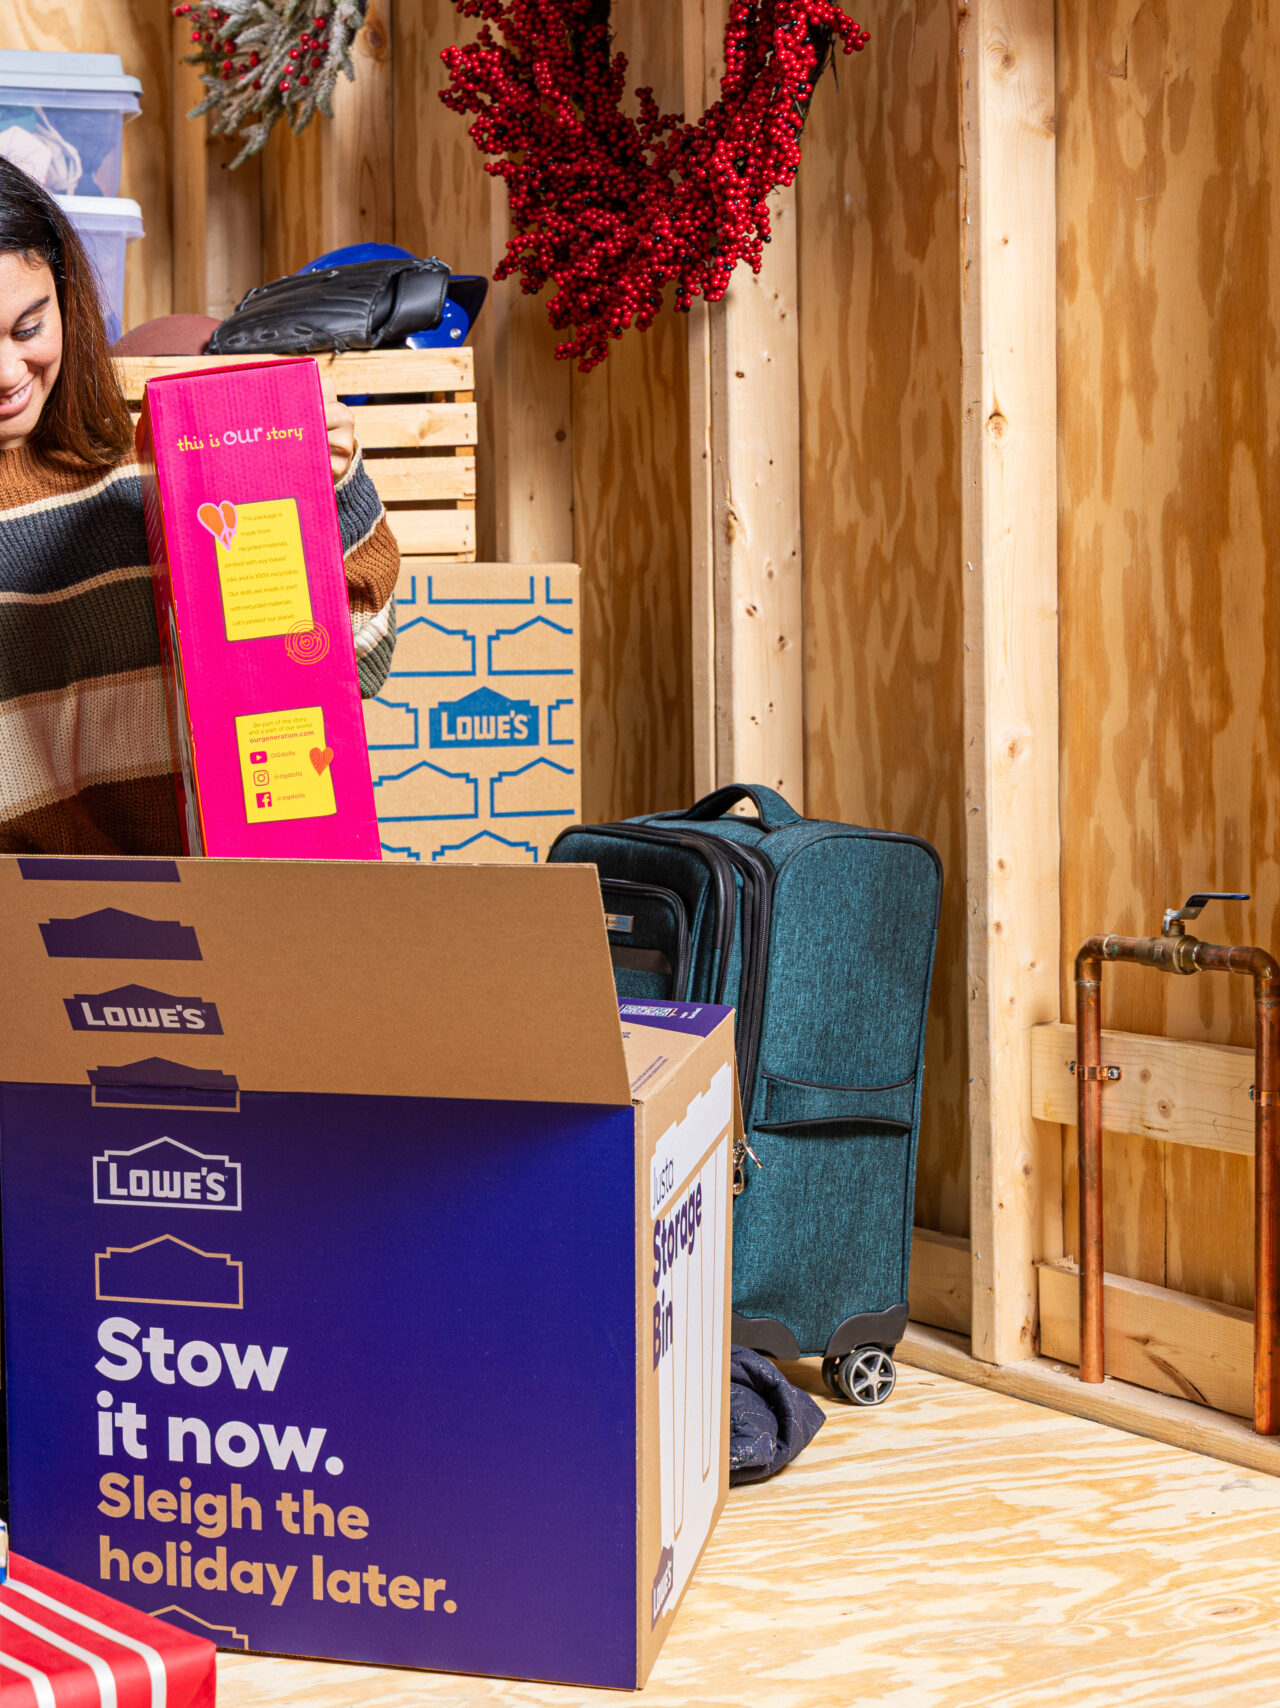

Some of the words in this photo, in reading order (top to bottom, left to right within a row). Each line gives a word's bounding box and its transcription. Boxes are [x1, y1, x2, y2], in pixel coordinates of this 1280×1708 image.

[177, 435, 204, 451] this
[209, 434, 220, 447] is
[266, 427, 304, 441] story
[250, 730, 315, 743] ourgeneration.com
[441, 710, 529, 741] LOWE'S
[81, 1003, 205, 1030] LOWE'S
[109, 1162, 226, 1202] LOWE'S
[653, 1182, 702, 1288] Storage
[95, 1317, 288, 1392] Stow
[653, 1289, 674, 1372] Bin
[96, 1390, 148, 1459] it
[168, 1415, 345, 1476] now.
[97, 1472, 263, 1538] Sleigh
[276, 1490, 370, 1540] the
[99, 1535, 298, 1606] holiday
[312, 1555, 458, 1614] later.
